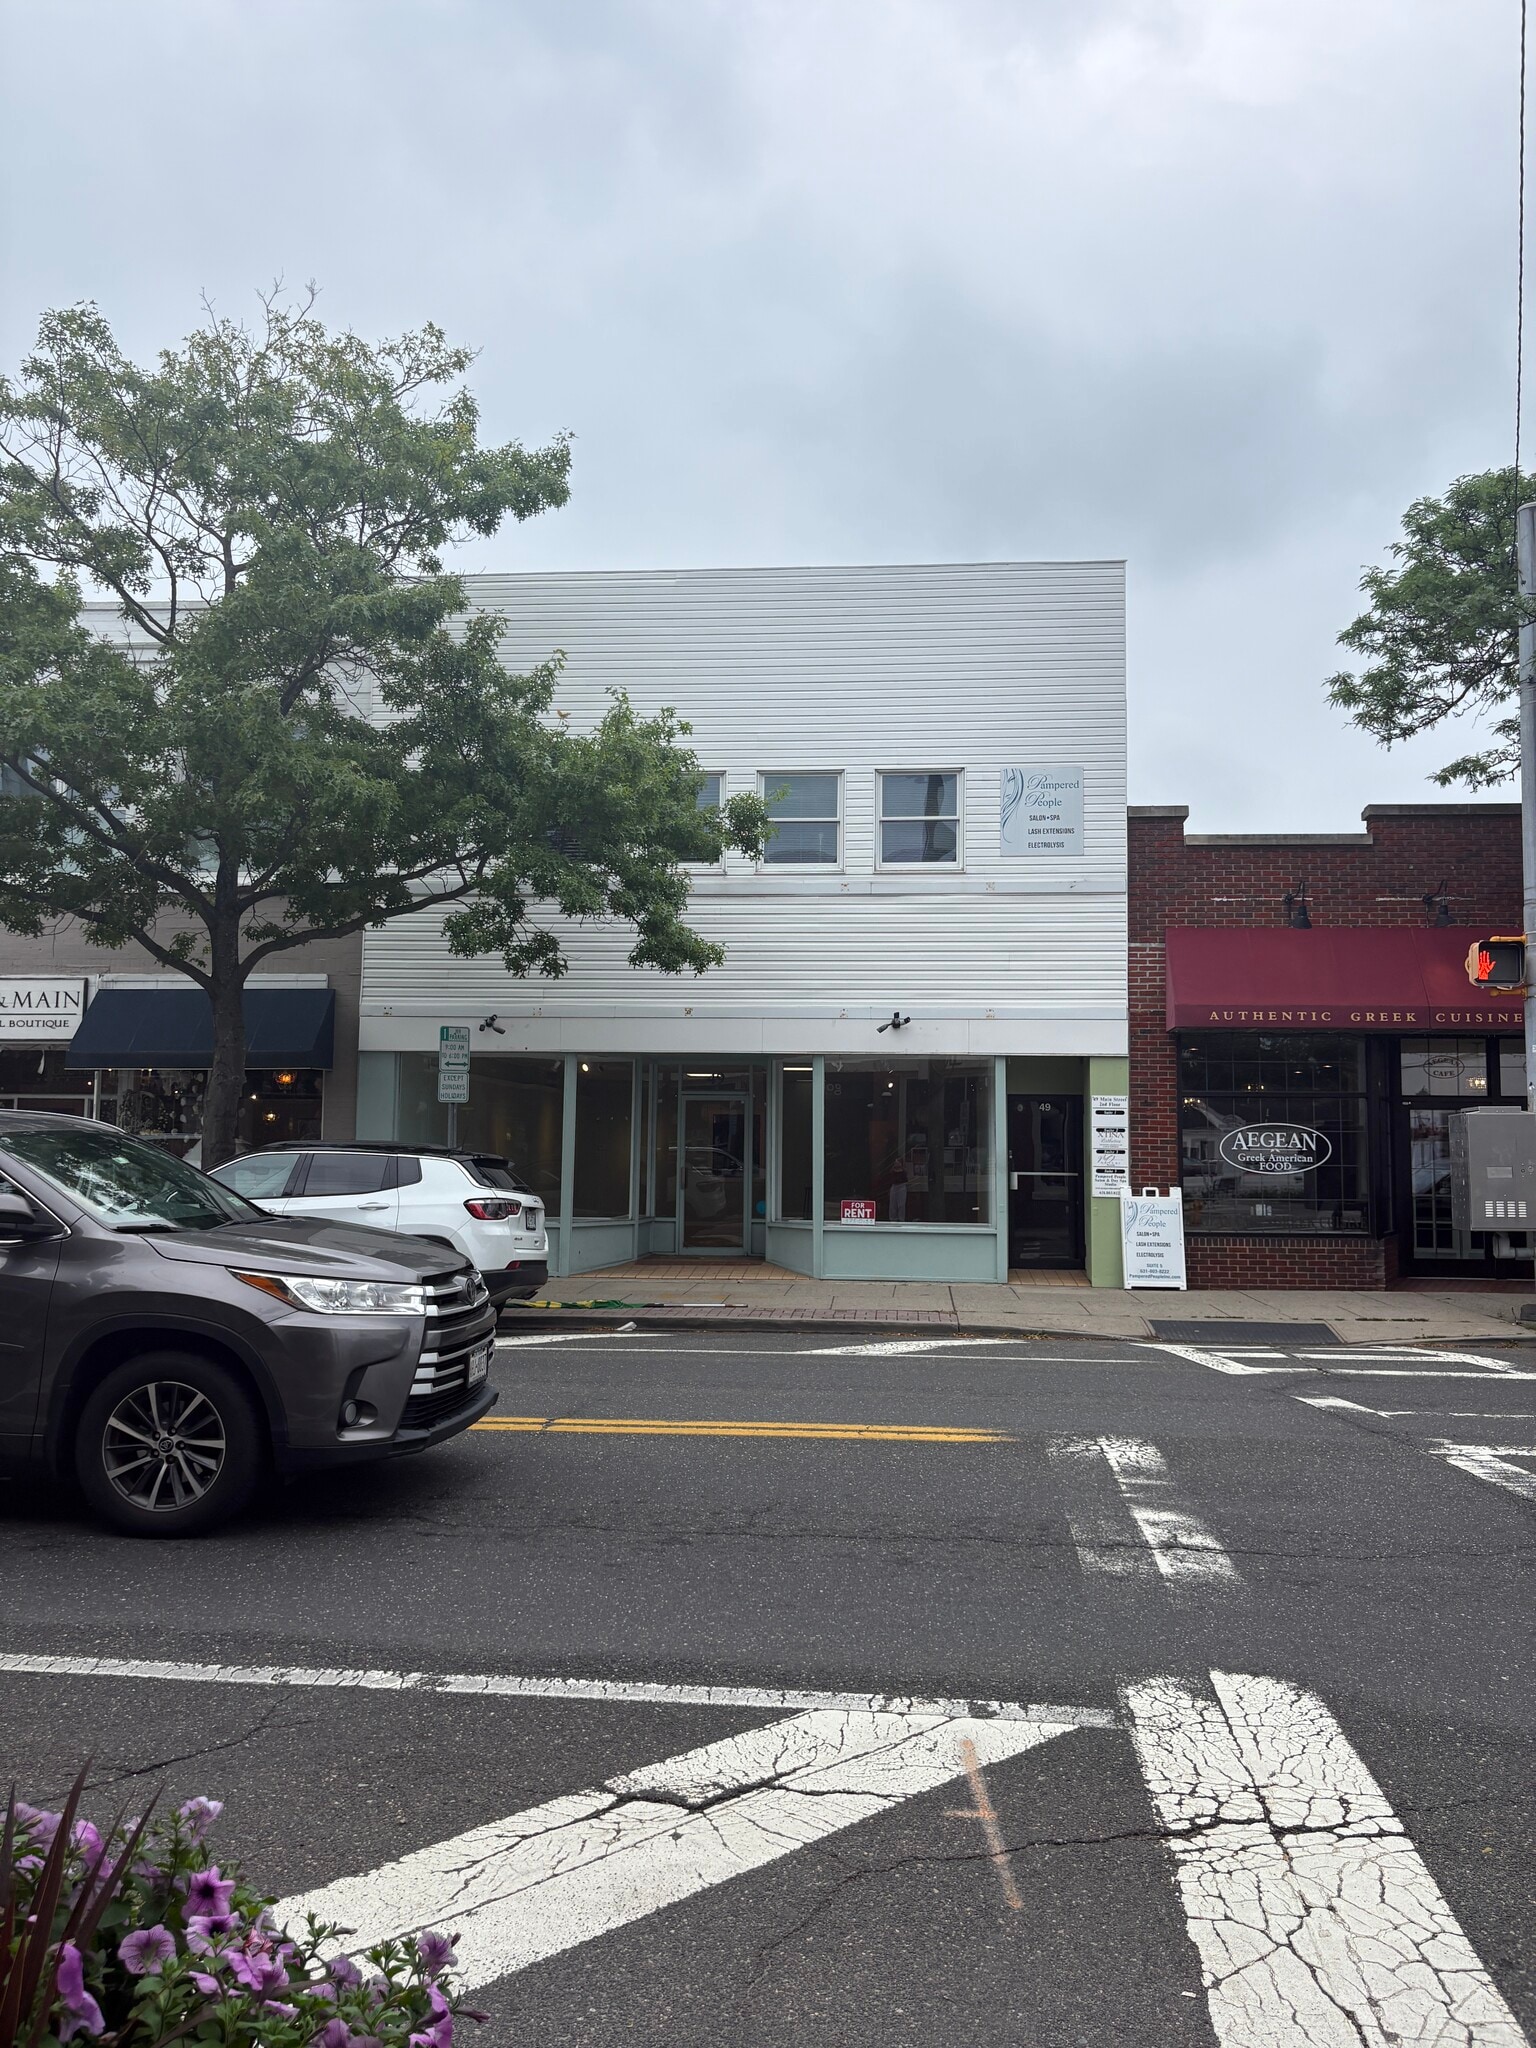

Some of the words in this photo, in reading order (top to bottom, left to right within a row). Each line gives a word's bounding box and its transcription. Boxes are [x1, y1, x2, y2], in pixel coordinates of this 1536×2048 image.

[1027, 774, 1080, 791] Pampered
[1025, 791, 1062, 808] People
[1028, 841, 1065, 849] ELECTROLYSIS
[12, 991, 80, 1008] MAIN
[1209, 1011, 1332, 1022] AUTHENTIC
[1350, 1011, 1418, 1023] GREEK
[1435, 1012, 1523, 1023] CUISINE
[9, 1019, 70, 1030] BOUTIQUE
[1039, 1103, 1051, 1111] 49
[1231, 1131, 1317, 1151] AEGEAN
[1237, 1153, 1266, 1162] Greek
[1268, 1153, 1314, 1163] American
[1260, 1162, 1292, 1171] FOOD
[844, 1208, 873, 1218] RENT
[1139, 1203, 1178, 1216] Pampered
[1138, 1215, 1167, 1229] People
